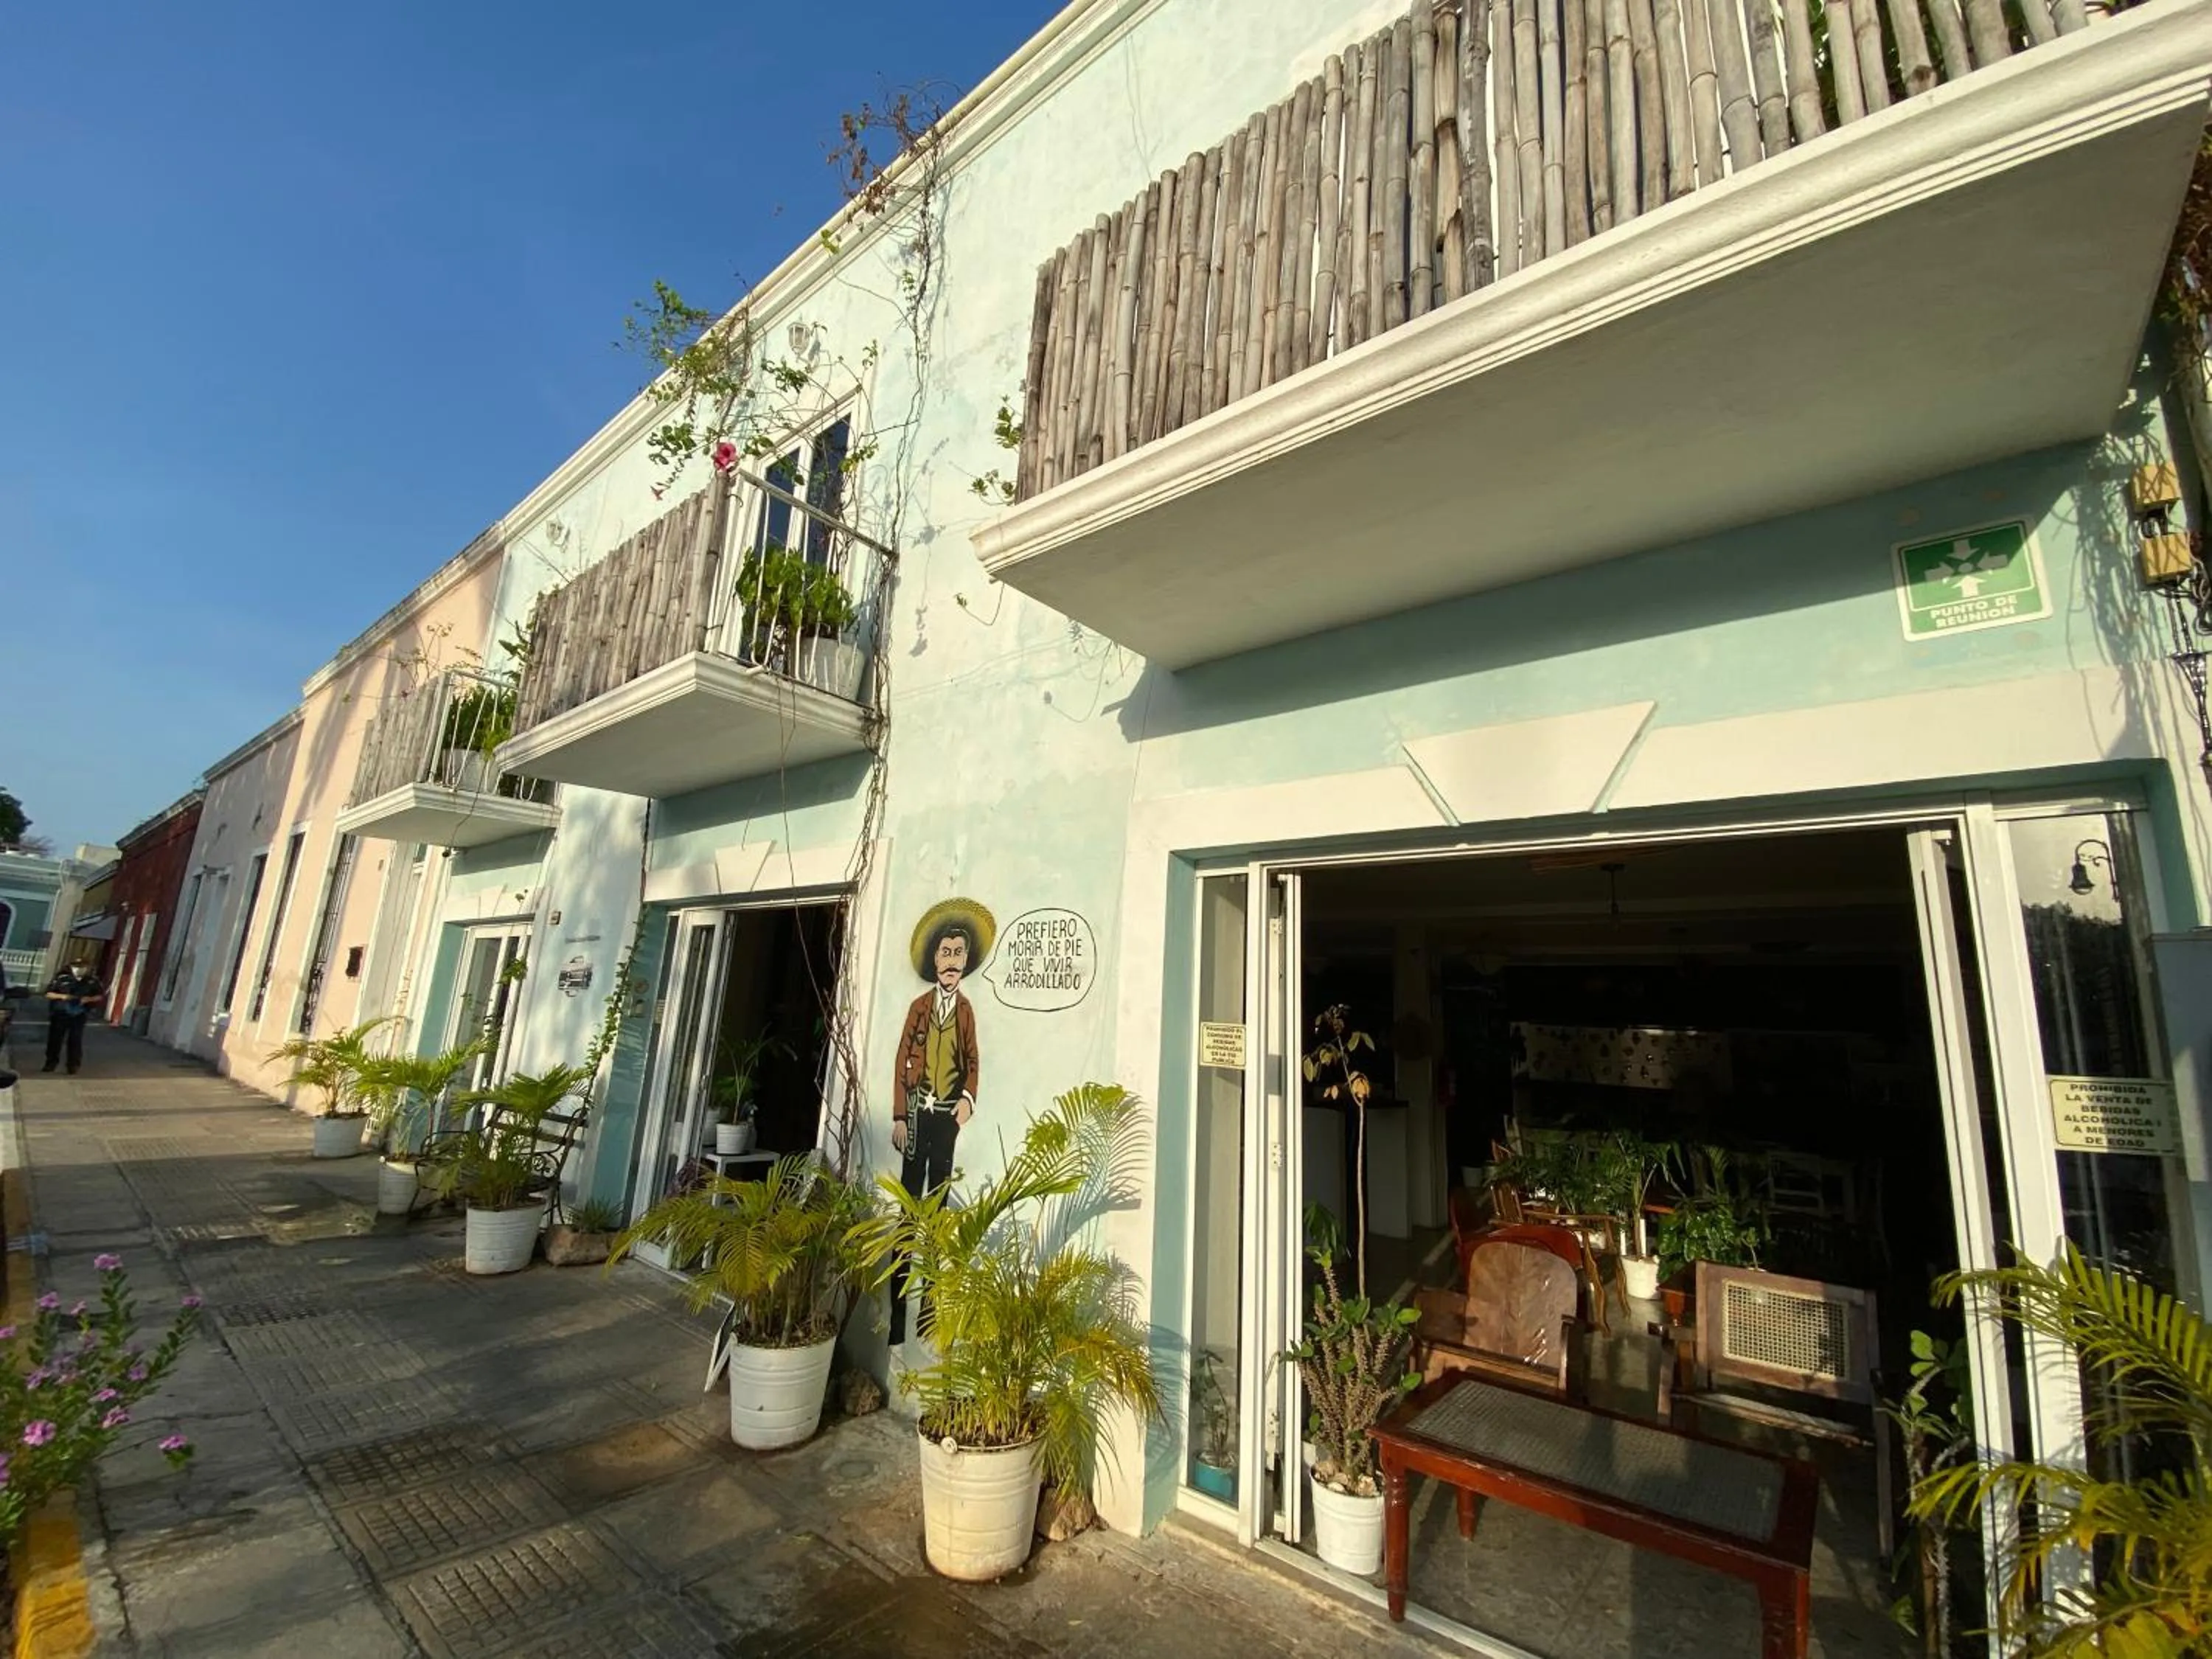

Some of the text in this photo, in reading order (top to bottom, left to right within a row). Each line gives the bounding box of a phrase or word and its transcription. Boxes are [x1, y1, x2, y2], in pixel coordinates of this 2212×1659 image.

[1930, 595, 2017, 619] PUNTO DE
[1935, 606, 2016, 628] REUNION
[1017, 918, 1077, 940] PREFIERO
[1008, 939, 1082, 957] MORIR DE PIE
[1012, 956, 1073, 973] QUE VIVIR
[1004, 973, 1081, 990] ARRODILLADO
[2069, 1084, 2147, 1094] PROHIBIDA
[2086, 1095, 2132, 1105] VENTA
[2080, 1105, 2141, 1115] BEBIDAS
[2086, 1127, 2155, 1137] MENORES
[2084, 1136, 2145, 1147] DE EDAD
